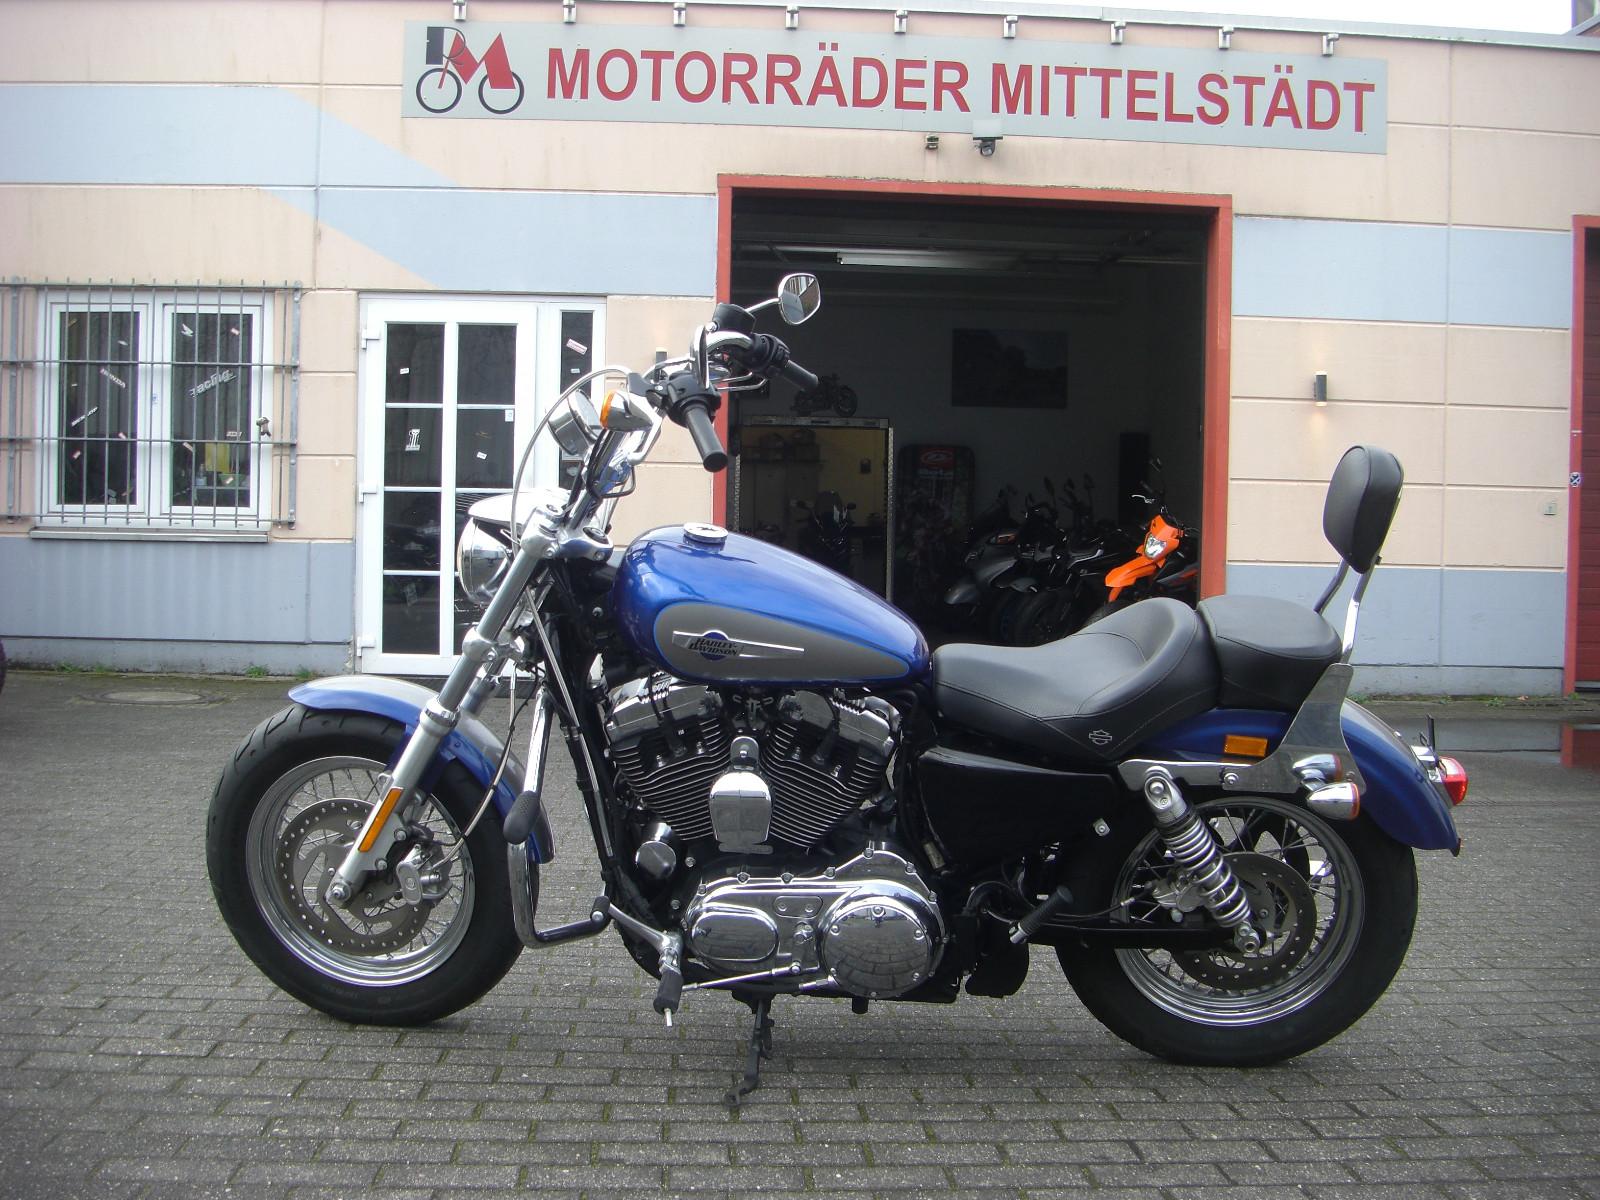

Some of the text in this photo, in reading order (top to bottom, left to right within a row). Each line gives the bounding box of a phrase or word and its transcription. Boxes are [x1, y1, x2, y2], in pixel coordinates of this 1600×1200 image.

[547, 42, 1376, 134] MOTORRÄDER MITTELSTÄDT
[688, 641, 737, 656] DAVIDSON
